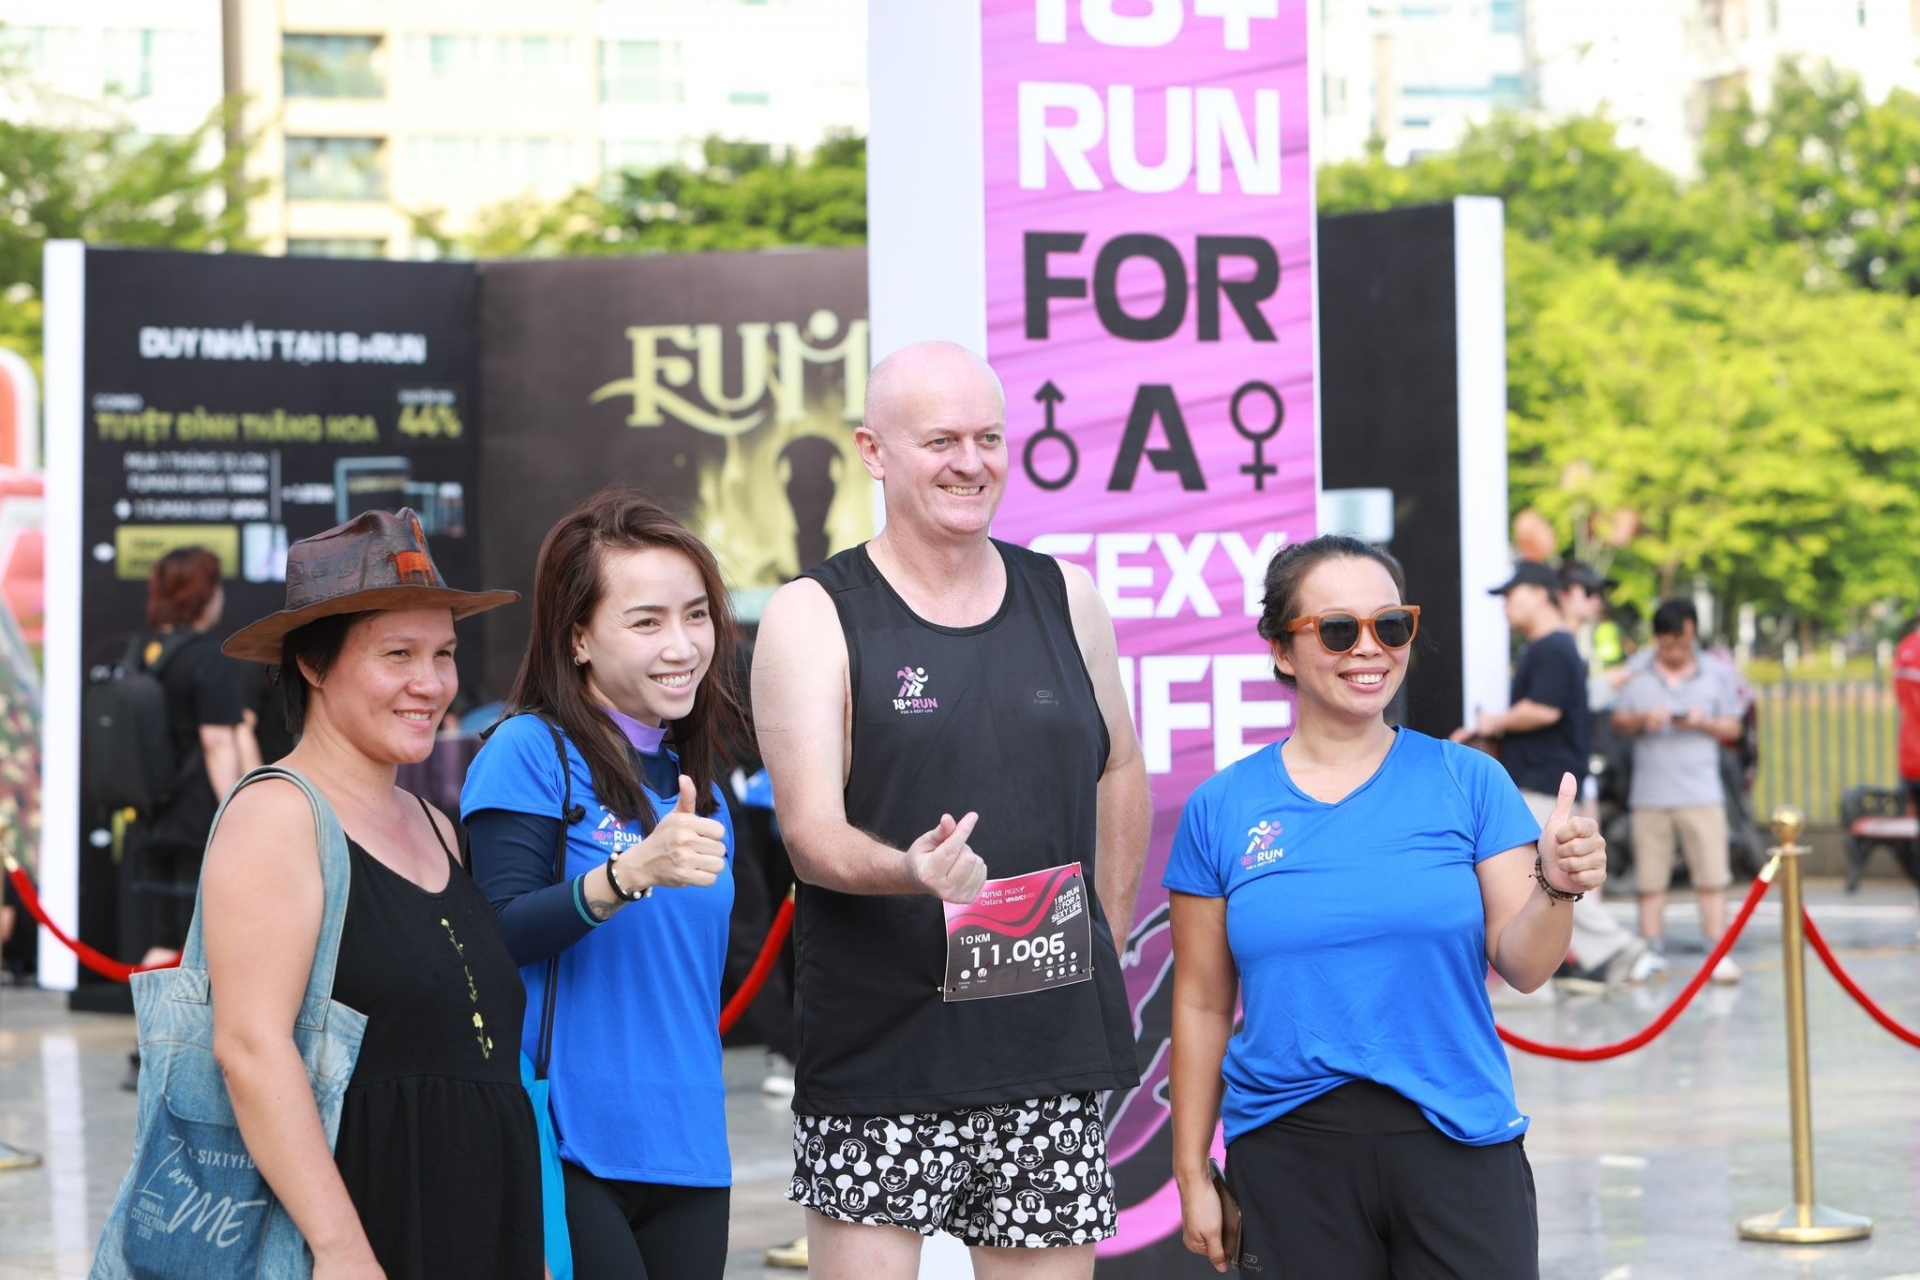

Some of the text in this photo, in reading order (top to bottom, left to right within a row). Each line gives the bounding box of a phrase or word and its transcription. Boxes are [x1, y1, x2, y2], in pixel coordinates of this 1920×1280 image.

[1018, 81, 1281, 195] RUN
[1024, 231, 1281, 342] FOR
[1106, 384, 1208, 491] A
[892, 698, 938, 710] 18+RUN
[1062, 893, 1080, 909] FOR A
[971, 932, 1065, 968] 11.006
[131, 1206, 168, 1232] COLLECTION
[167, 1186, 267, 1248] ME
